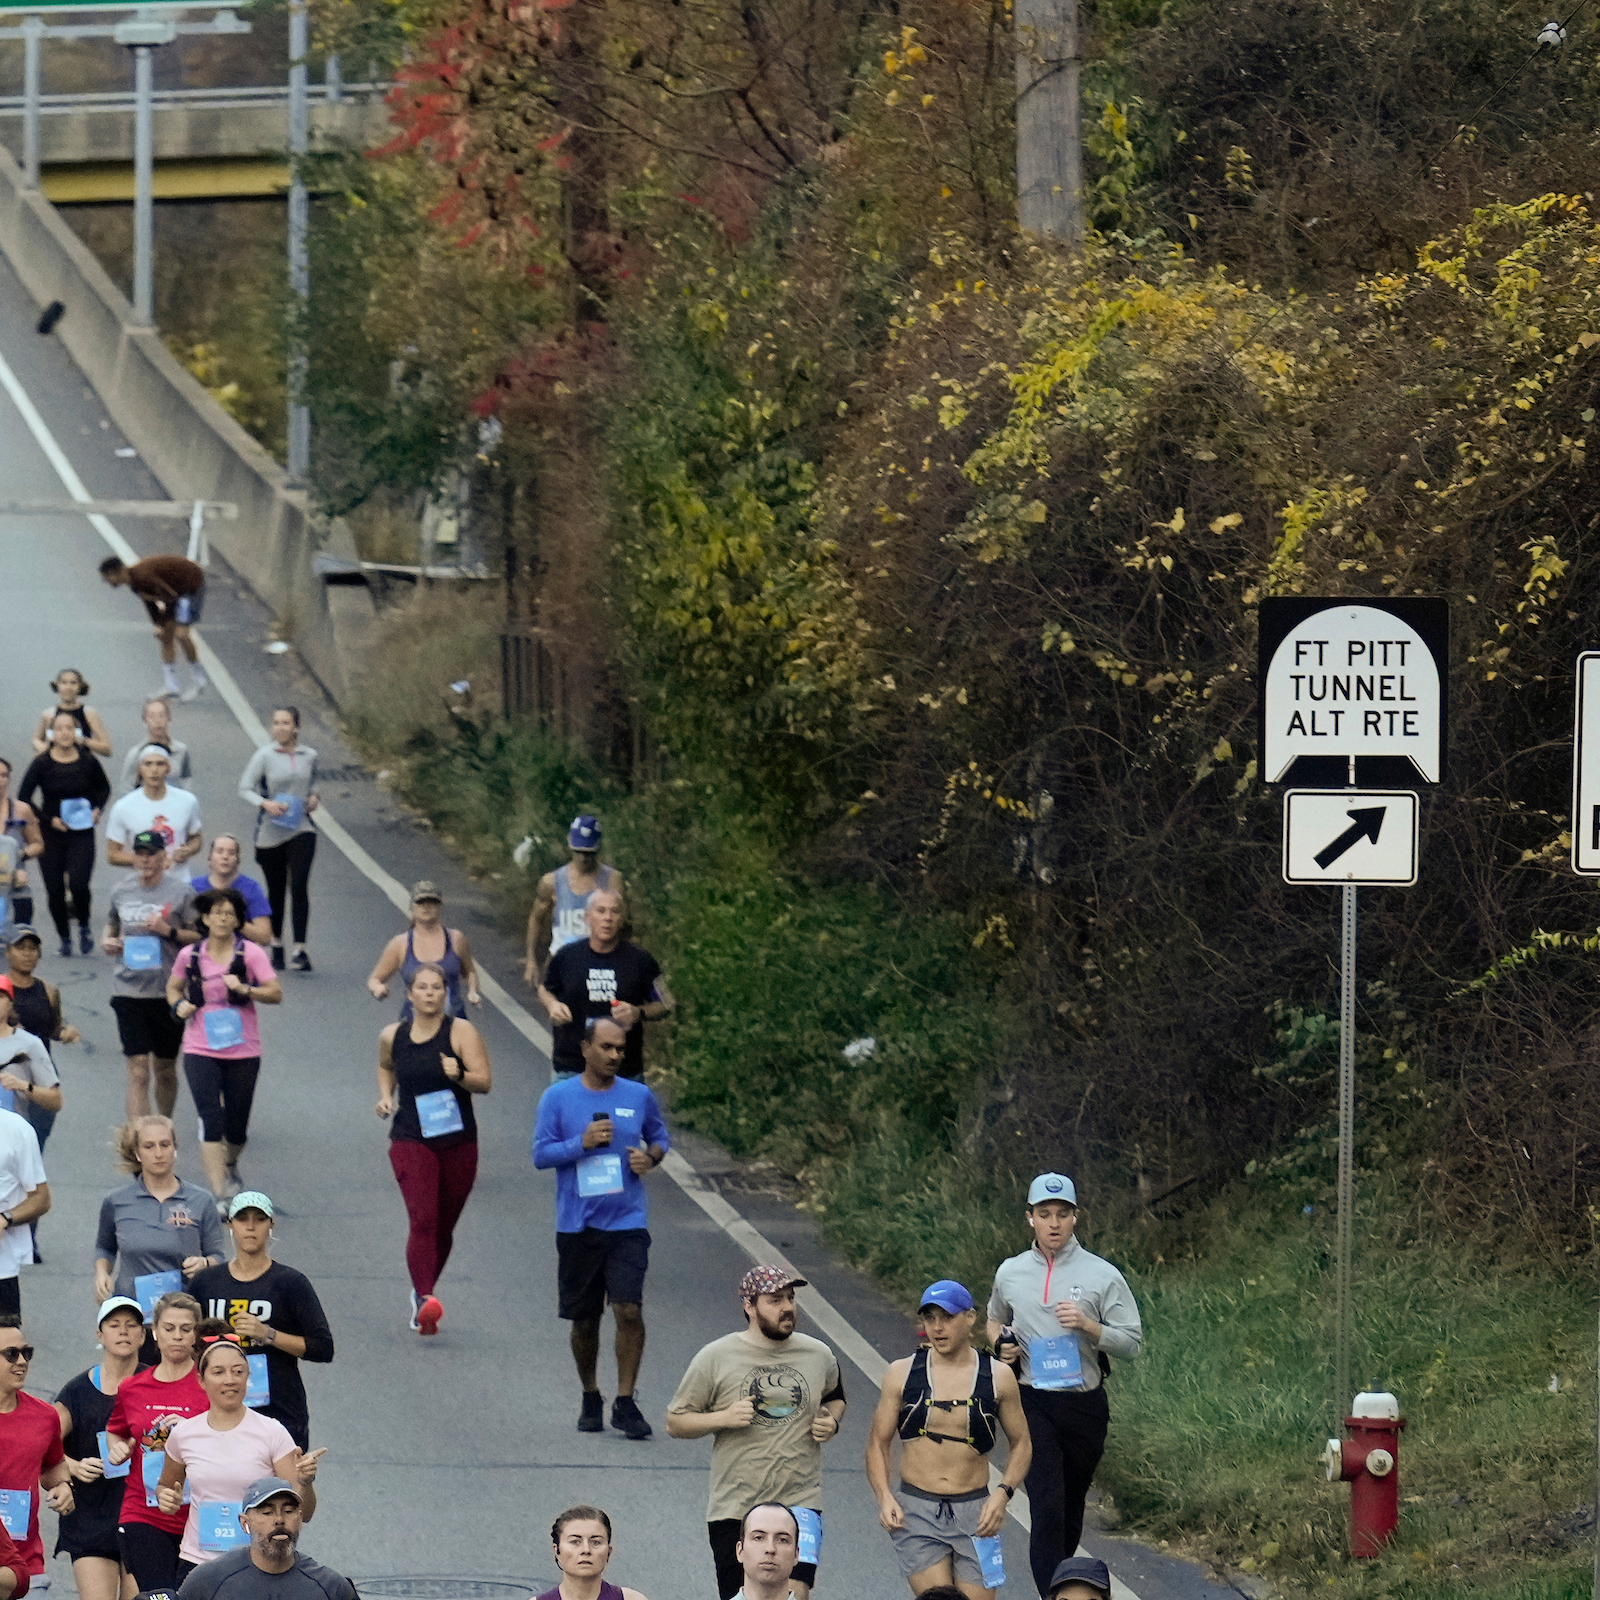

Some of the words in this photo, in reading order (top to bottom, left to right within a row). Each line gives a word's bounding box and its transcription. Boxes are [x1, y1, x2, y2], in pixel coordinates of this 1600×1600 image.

[1294, 640, 1330, 667] FT
[1347, 640, 1412, 667] PITT
[1289, 674, 1417, 701] TUNNEL
[1286, 710, 1346, 737] ALT
[1363, 710, 1421, 737] RTE
[214, 1527, 235, 1537] 923
